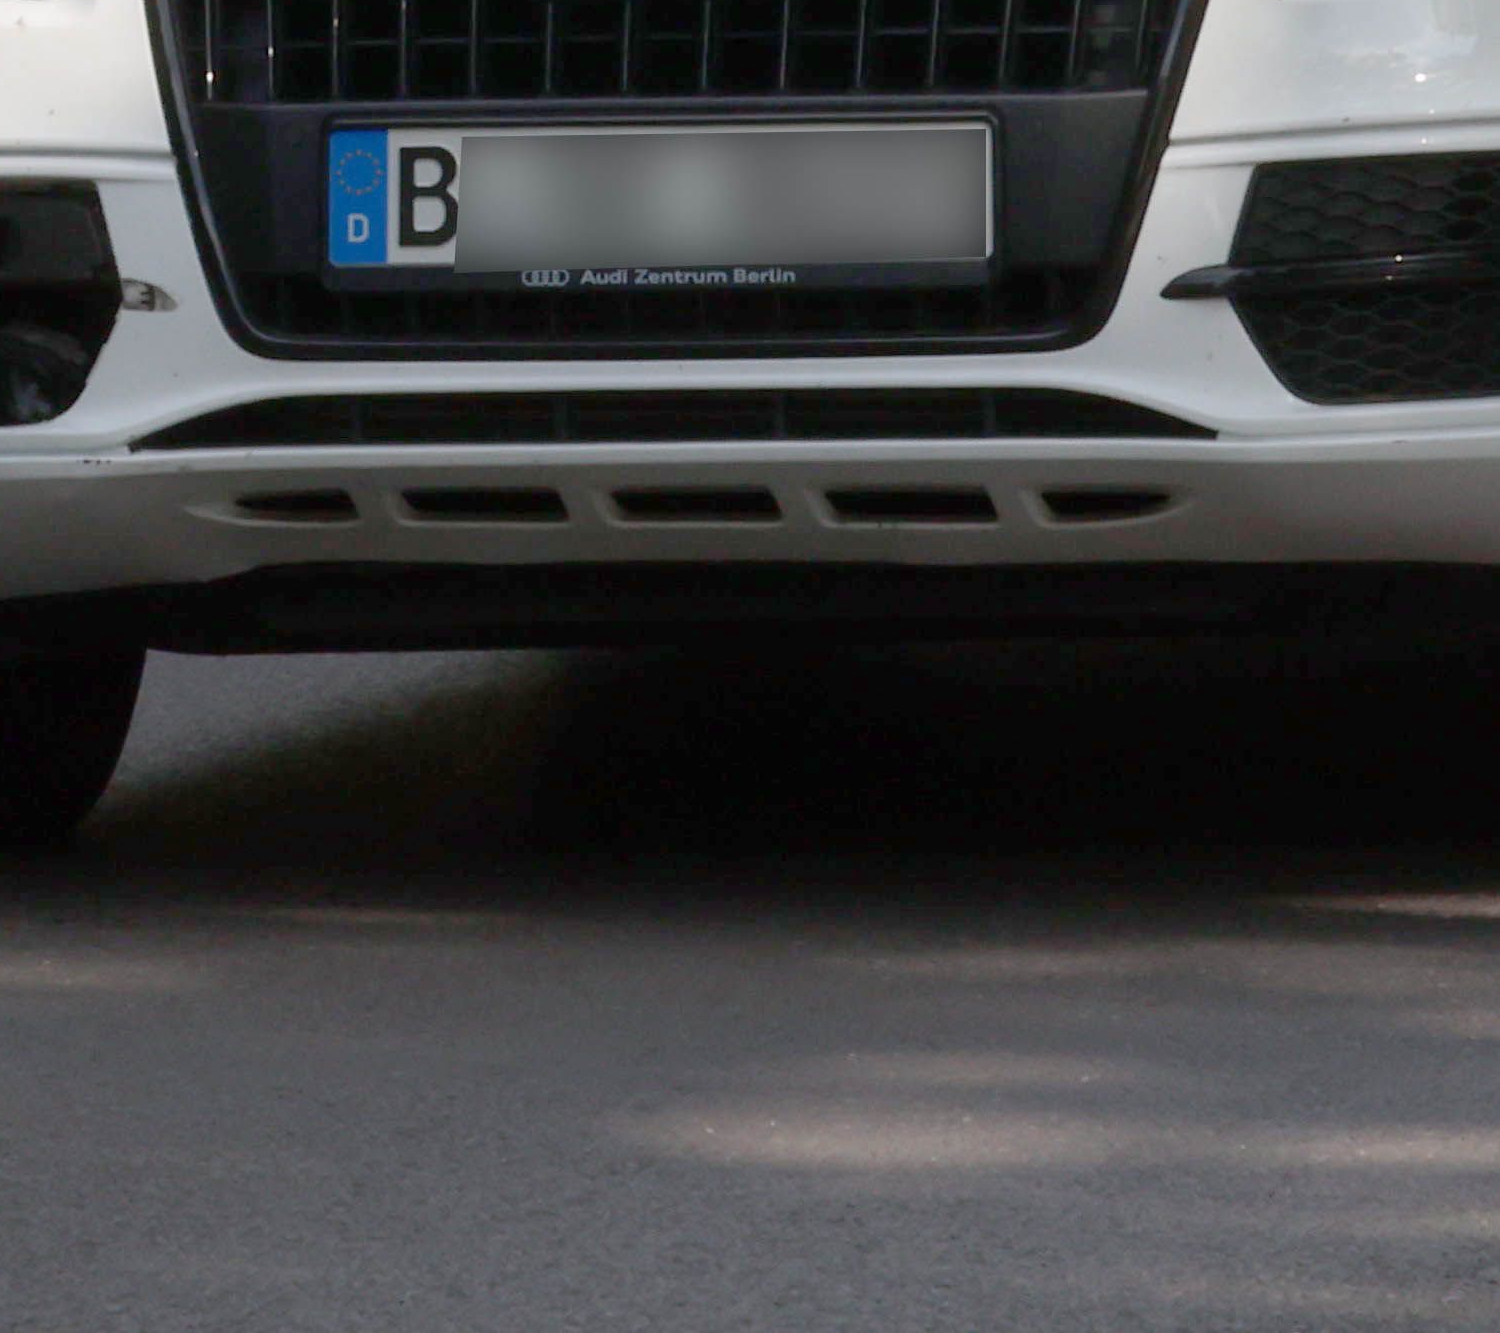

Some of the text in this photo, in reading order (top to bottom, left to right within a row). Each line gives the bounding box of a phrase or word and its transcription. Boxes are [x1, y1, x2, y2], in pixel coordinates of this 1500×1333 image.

[399, 146, 459, 248] B
[348, 213, 370, 244] D
[580, 267, 797, 284] Audi Zentrum Berlin
